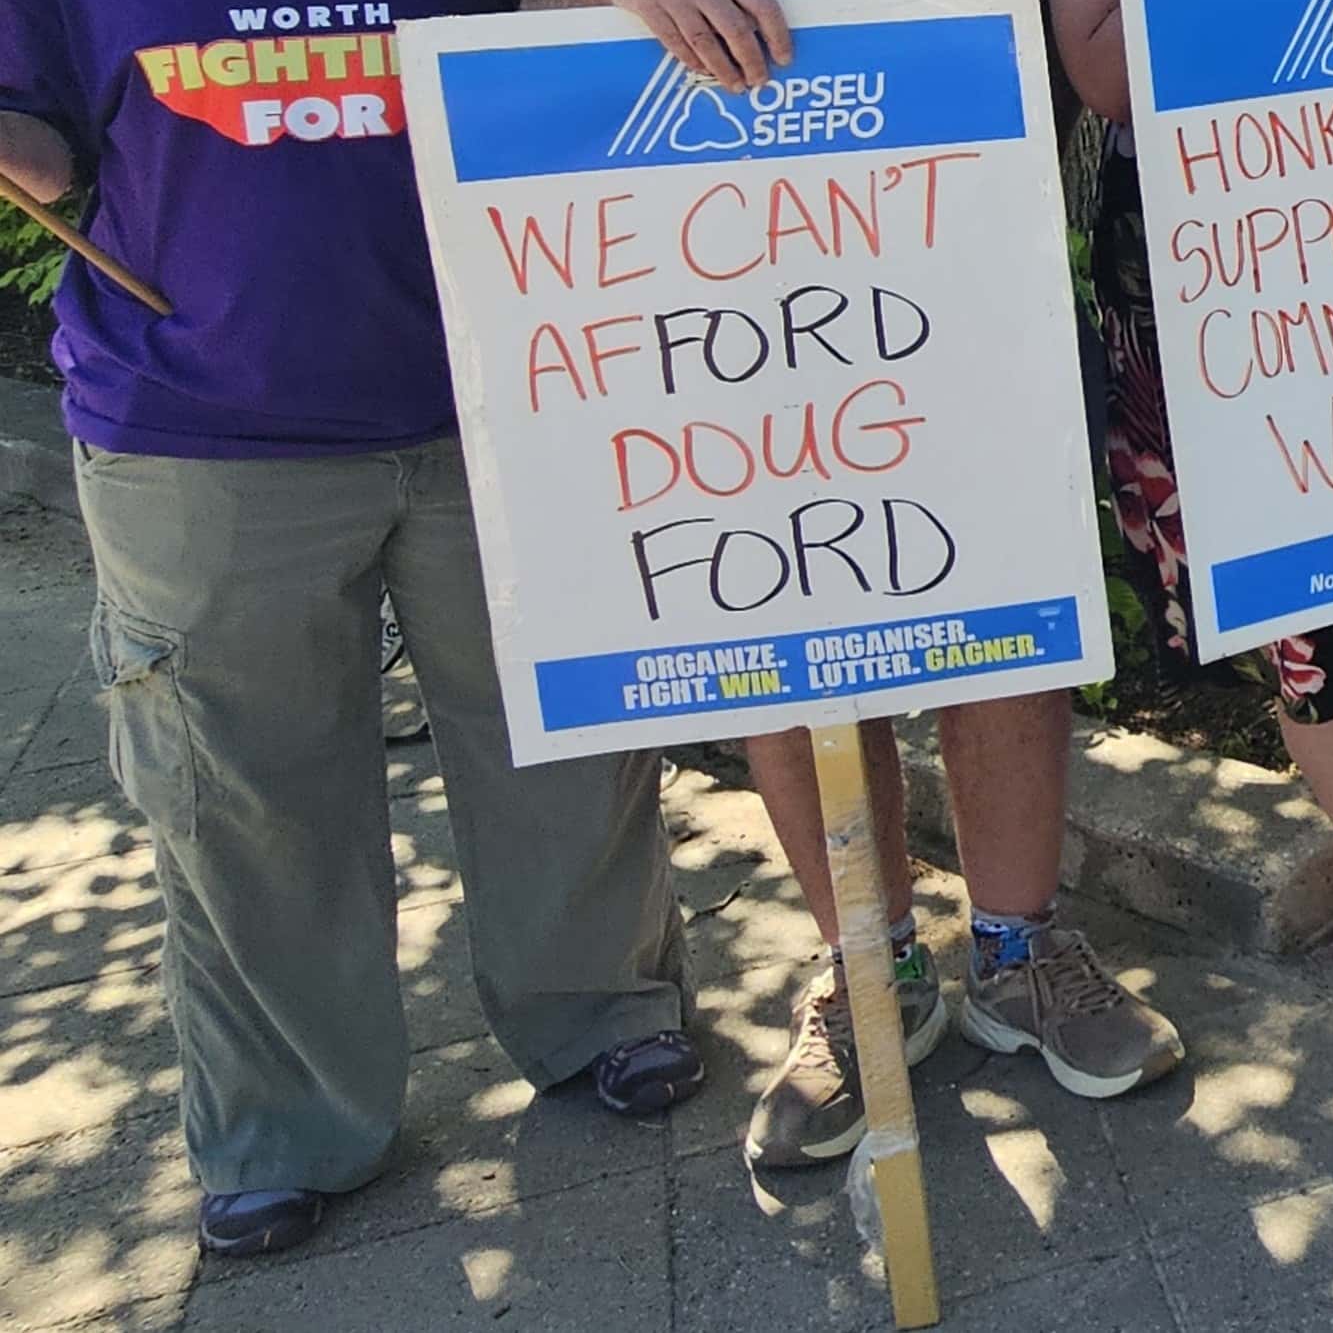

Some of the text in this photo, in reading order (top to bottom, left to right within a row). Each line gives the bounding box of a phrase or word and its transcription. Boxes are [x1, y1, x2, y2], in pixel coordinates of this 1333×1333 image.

[228, 3, 391, 32] WORTH
[748, 72, 885, 112] OPSEU
[241, 94, 393, 146] FOR
[750, 110, 885, 147] SEFPO
[487, 152, 983, 295] WE CAN'T
[526, 284, 931, 413] AFFORD
[610, 379, 927, 512] DOUG
[631, 498, 957, 620] FORD
[635, 643, 787, 682] ORGANIZE.
[805, 619, 976, 665] ORGANISER.
[808, 633, 1045, 691] LUTTER. GAGNER.
[623, 669, 792, 710] FIGHT. WIN.
